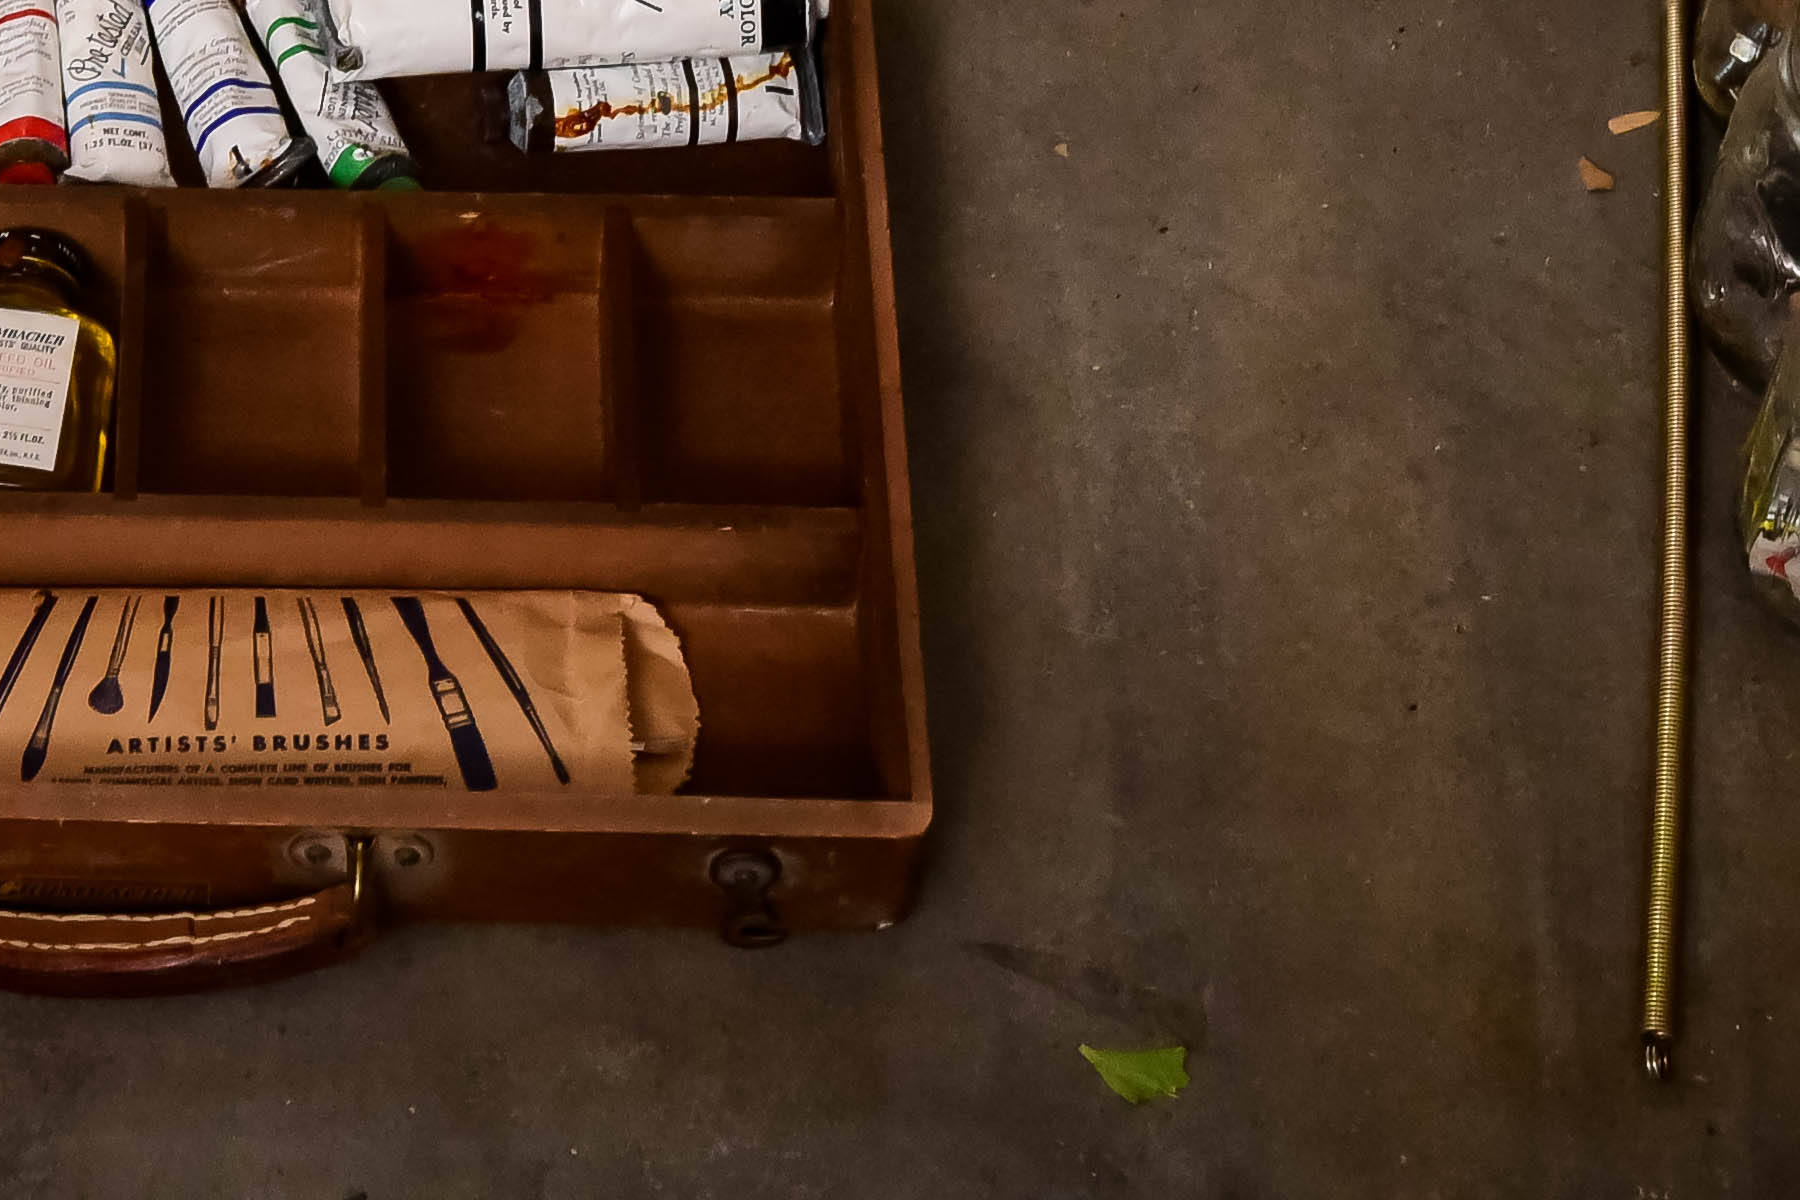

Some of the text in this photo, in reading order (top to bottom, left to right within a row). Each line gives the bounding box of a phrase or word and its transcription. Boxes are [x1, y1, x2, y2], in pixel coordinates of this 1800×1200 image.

[513, 0, 523, 10] of
[502, 20, 513, 34] by
[20, 343, 57, 354] QUALITY
[33, 357, 57, 371] OIL
[12, 386, 53, 399] purified
[12, 394, 52, 409] thinning
[106, 734, 390, 755] ARTISTS' BRUSHES
[83, 764, 179, 775] MANUFACTURERS
[185, 764, 201, 774] OF
[205, 764, 214, 774] A
[220, 764, 278, 774] COMPLETE
[283, 763, 308, 773] LINE
[313, 763, 329, 773] OF
[388, 763, 412, 773] FOR
